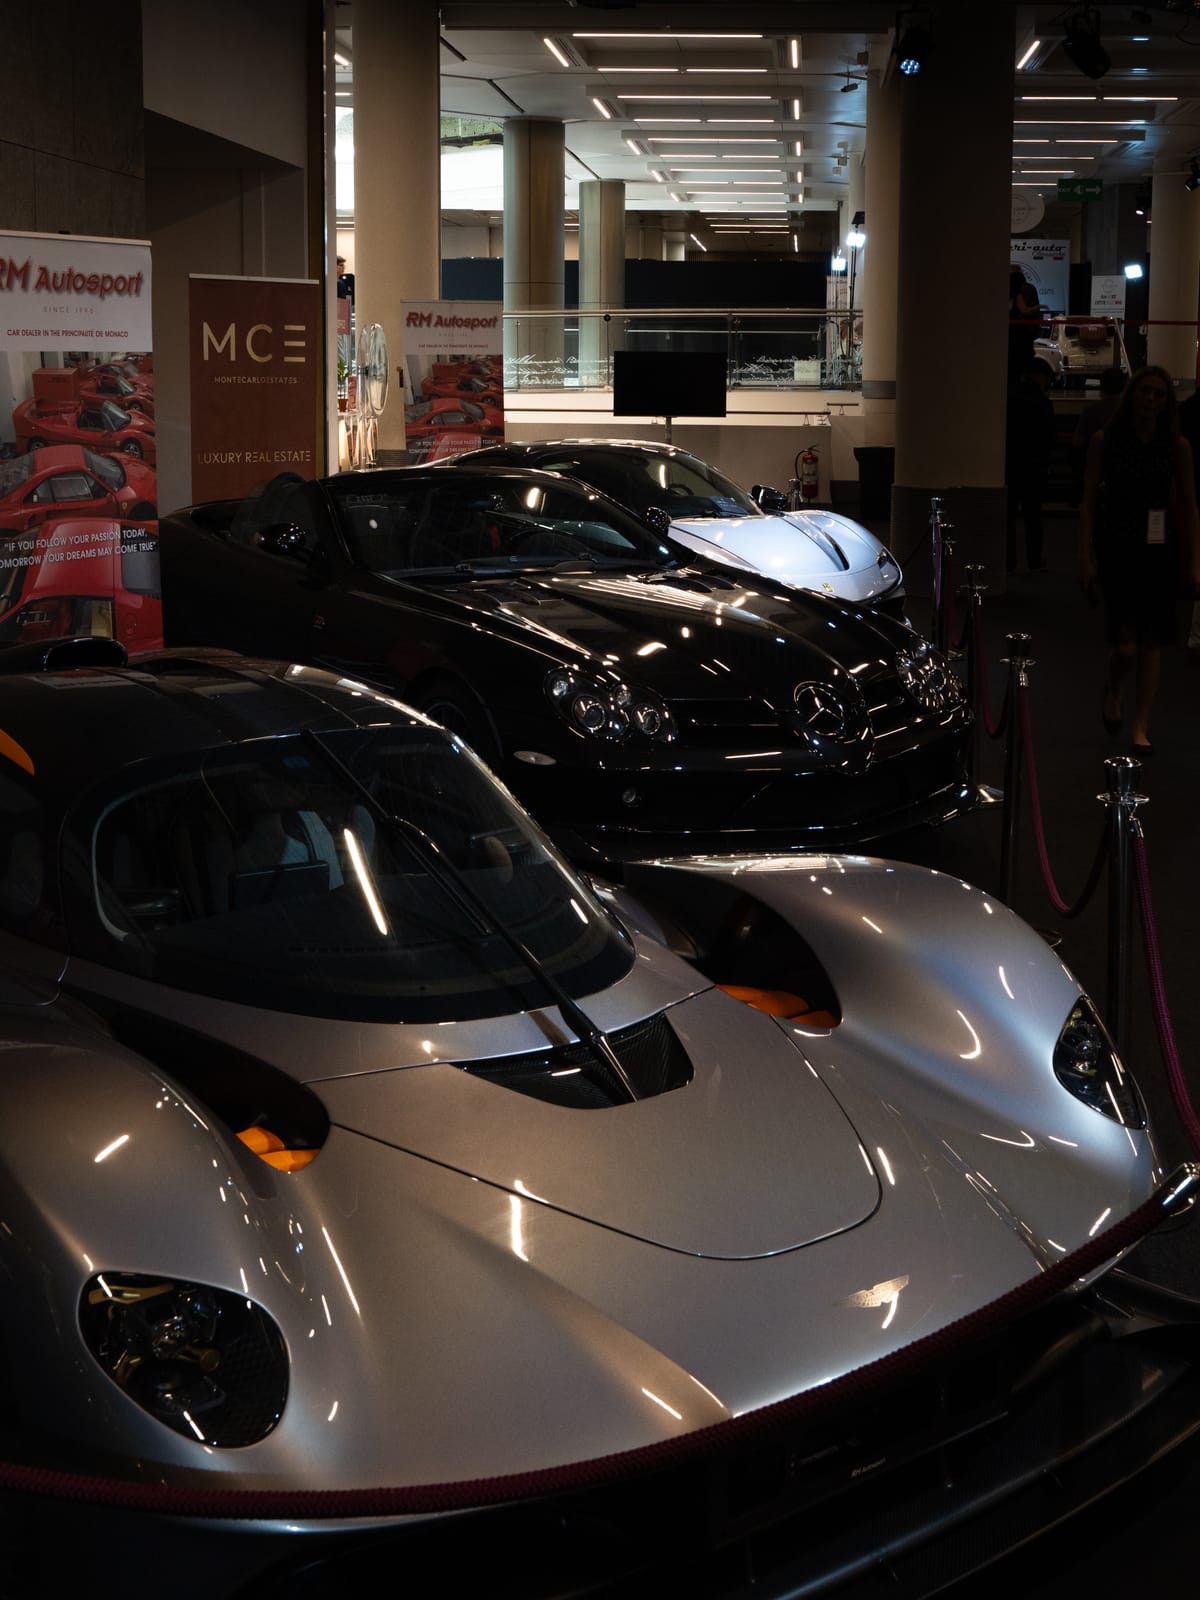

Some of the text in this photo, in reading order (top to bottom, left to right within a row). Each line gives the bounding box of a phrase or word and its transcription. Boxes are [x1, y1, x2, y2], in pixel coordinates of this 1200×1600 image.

[1010, 242, 1066, 252] ri-auto
[35, 266, 143, 300] Autosport
[406, 312, 498, 331] RM Autosport
[7, 329, 20, 337] CAR
[21, 329, 42, 337] DEALER
[95, 330, 103, 338] DE
[203, 321, 306, 363] MCE
[198, 450, 311, 464] LUXURY REAL ESTATE
[17, 541, 34, 551] YOU
[36, 537, 67, 549] FOLLOW
[69, 535, 89, 545] YOUR
[91, 531, 121, 542] PASSION
[0, 556, 41, 569] OMORROW
[44, 553, 64, 563] YOUR
[66, 550, 97, 560] DREAMS
[98, 547, 113, 556] MAY
[115, 543, 138, 554] COME
